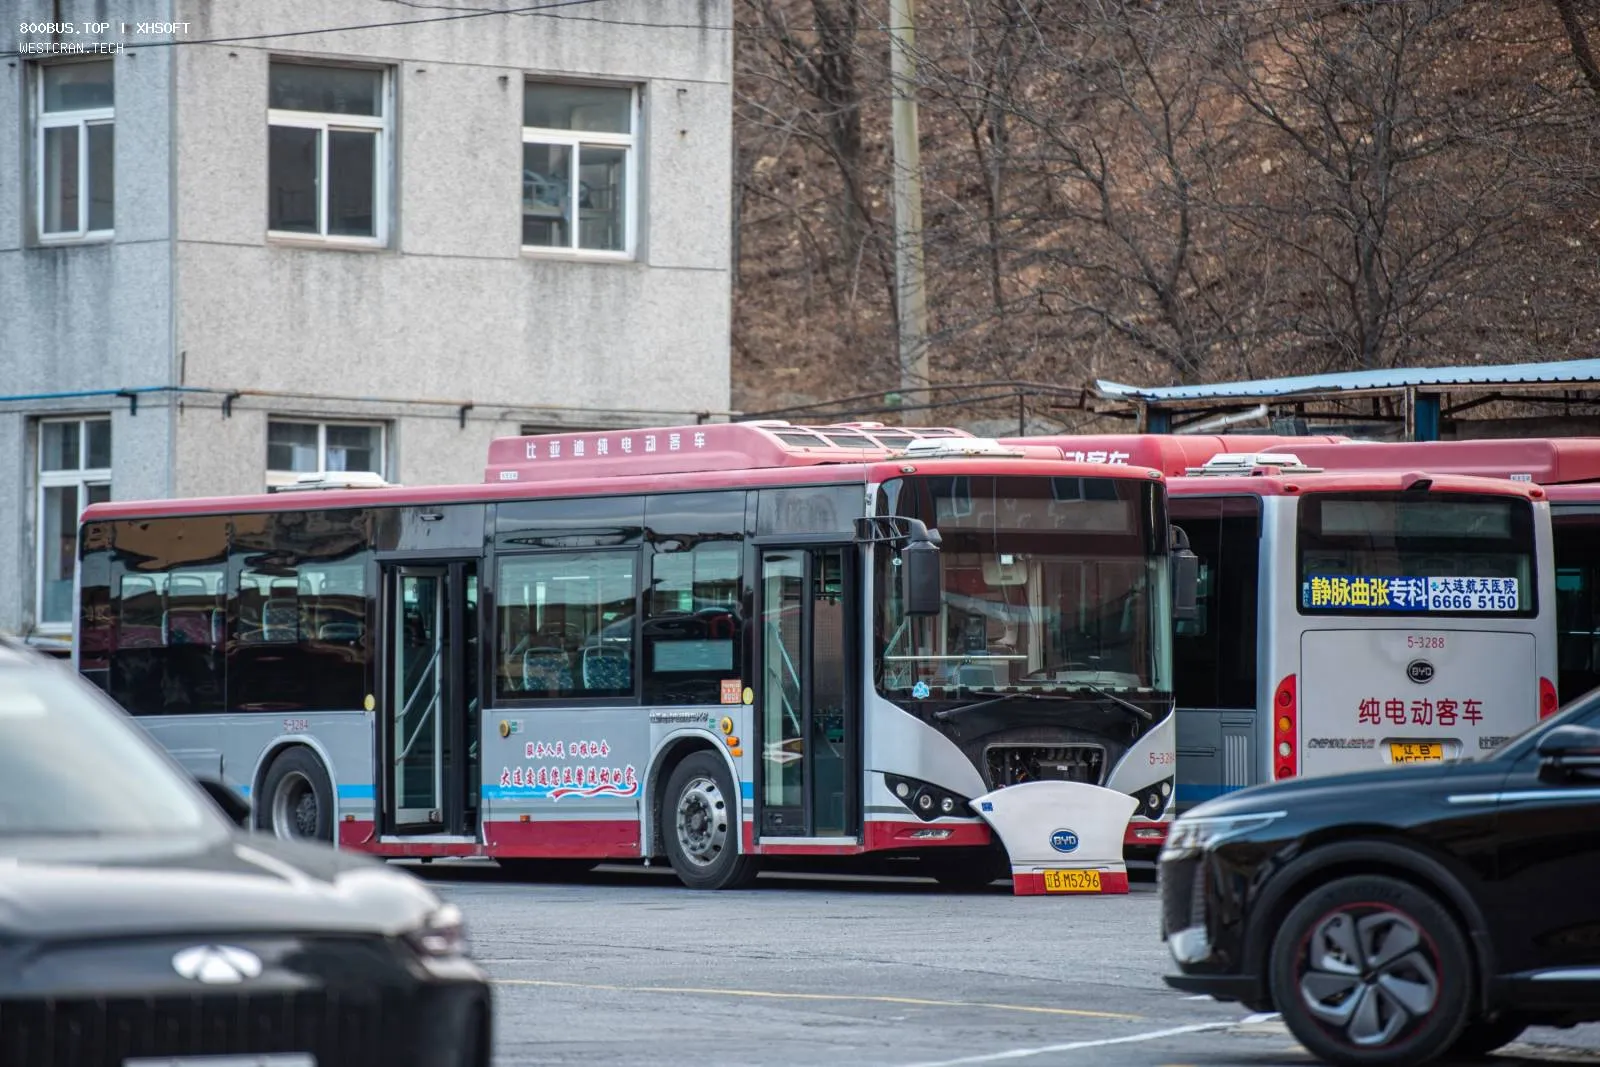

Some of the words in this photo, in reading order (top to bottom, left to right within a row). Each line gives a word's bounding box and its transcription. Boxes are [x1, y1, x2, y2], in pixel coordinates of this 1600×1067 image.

[526, 432, 706, 459] 比亚迪纯电动客车
[1311, 577, 1427, 607] 静脉曲张专科
[1440, 578, 1516, 595] 大连航天医院
[1432, 595, 1472, 609] 6666
[1478, 595, 1516, 609] 5150
[1407, 636, 1445, 649] 5-3288
[1411, 666, 1432, 676] BYD
[1358, 697, 1484, 726] 纯电动客车
[1053, 836, 1076, 846] BYD
